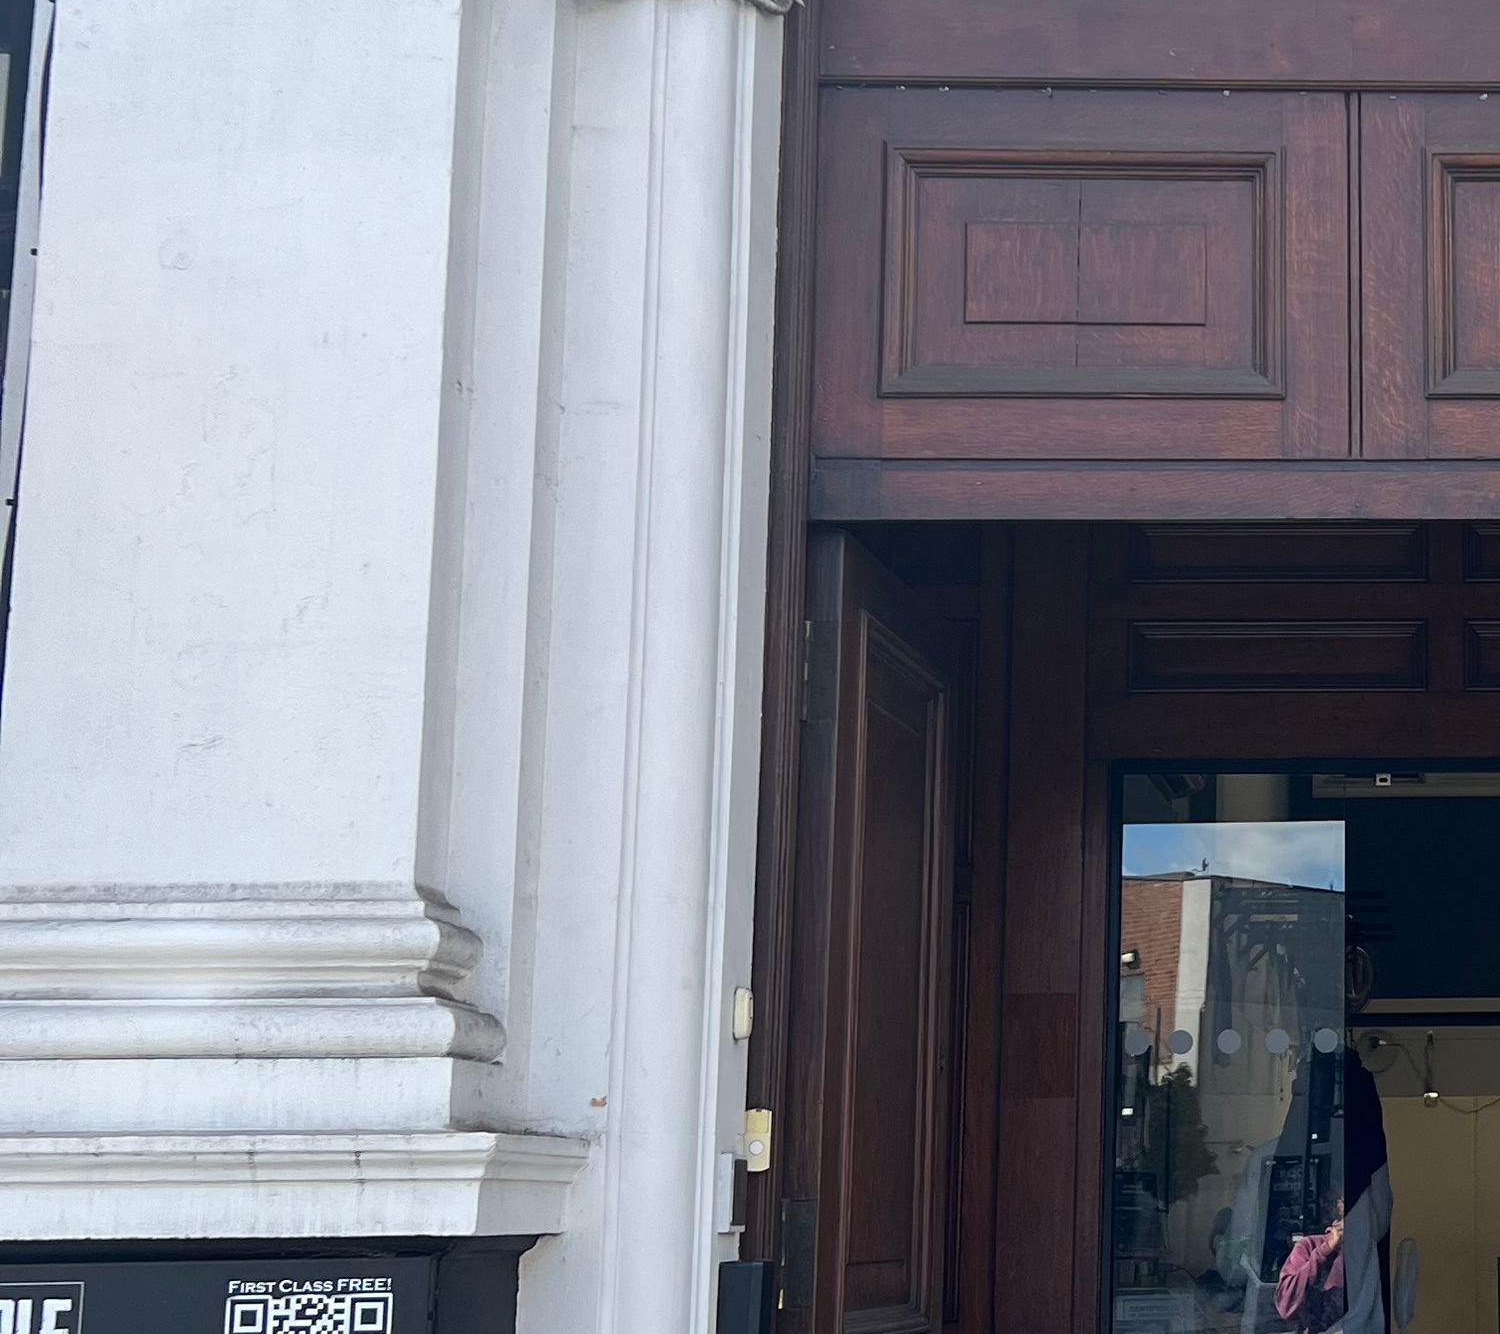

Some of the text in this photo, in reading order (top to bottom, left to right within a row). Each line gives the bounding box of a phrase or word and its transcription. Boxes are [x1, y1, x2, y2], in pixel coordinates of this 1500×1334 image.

[229, 1277, 391, 1294] FIRST CLASS FREE!
